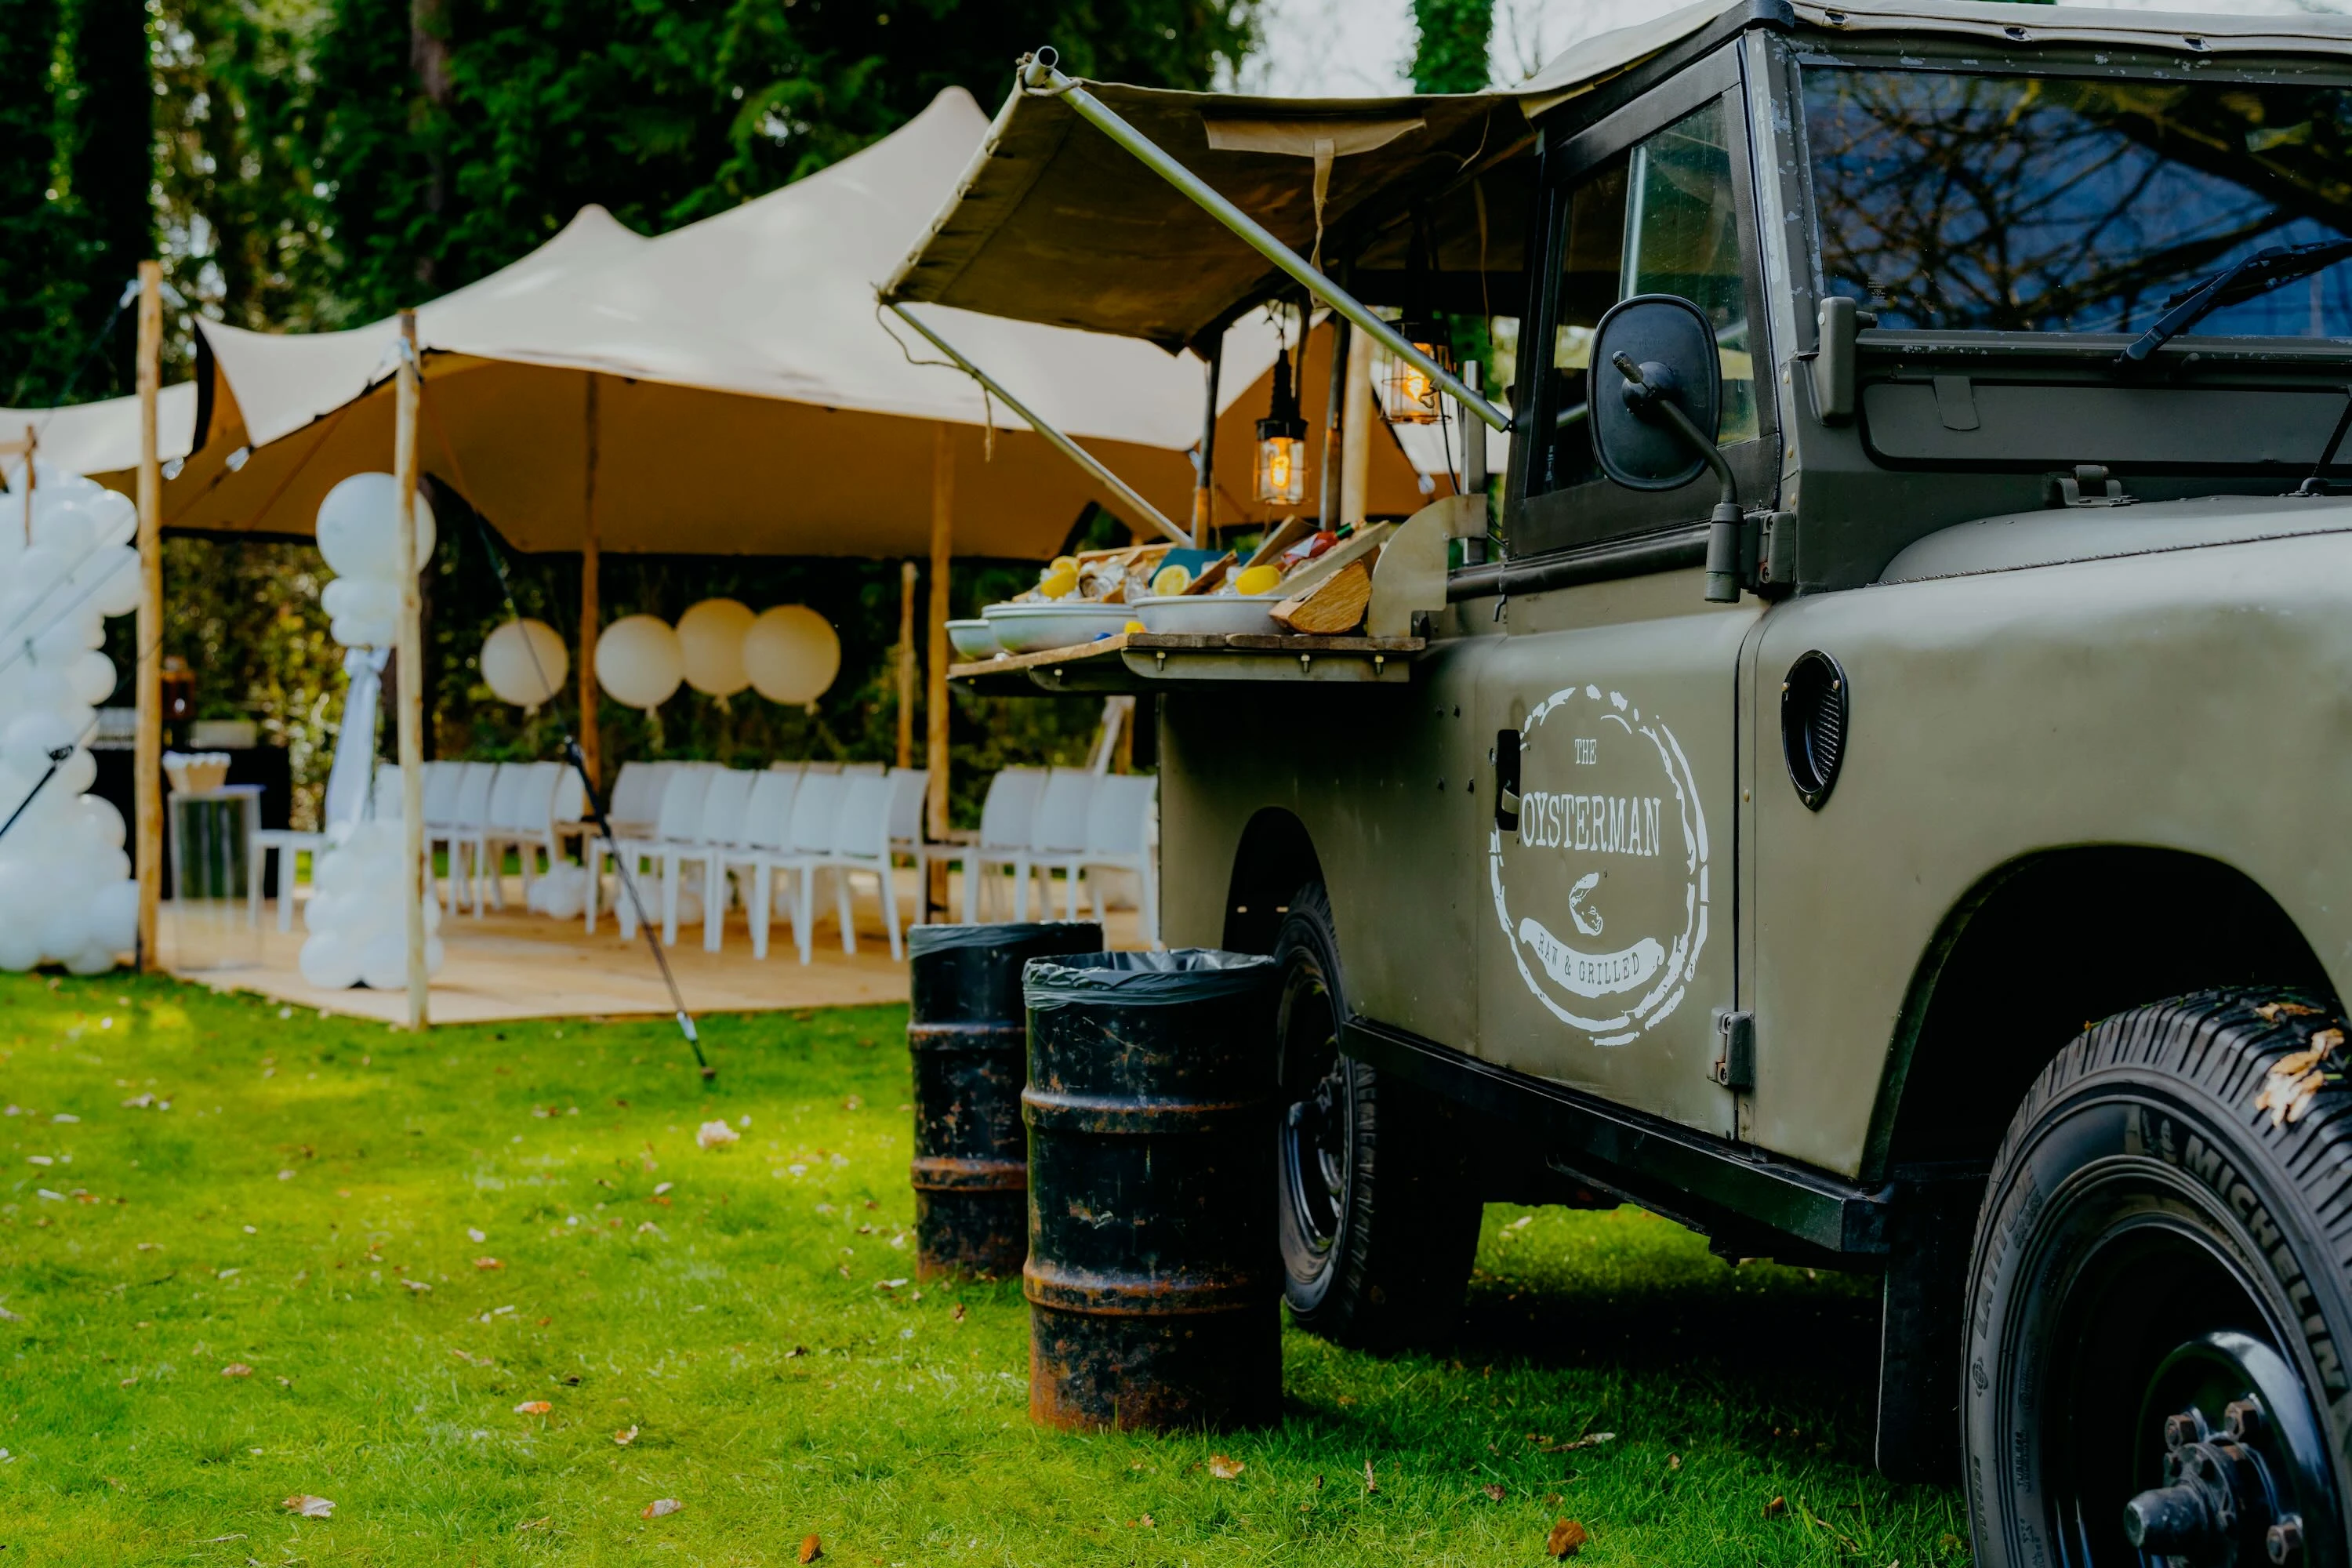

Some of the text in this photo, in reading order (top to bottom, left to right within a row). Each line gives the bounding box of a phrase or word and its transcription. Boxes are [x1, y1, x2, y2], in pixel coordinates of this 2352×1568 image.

[1574, 739, 1597, 765] THE
[1522, 791, 1661, 856] OYSTERMAN
[1537, 932, 1639, 985] RAW & GRILLED
[1974, 1163, 2038, 1340] LATITUDE
[2184, 1134, 2348, 1391] MICHELIN
